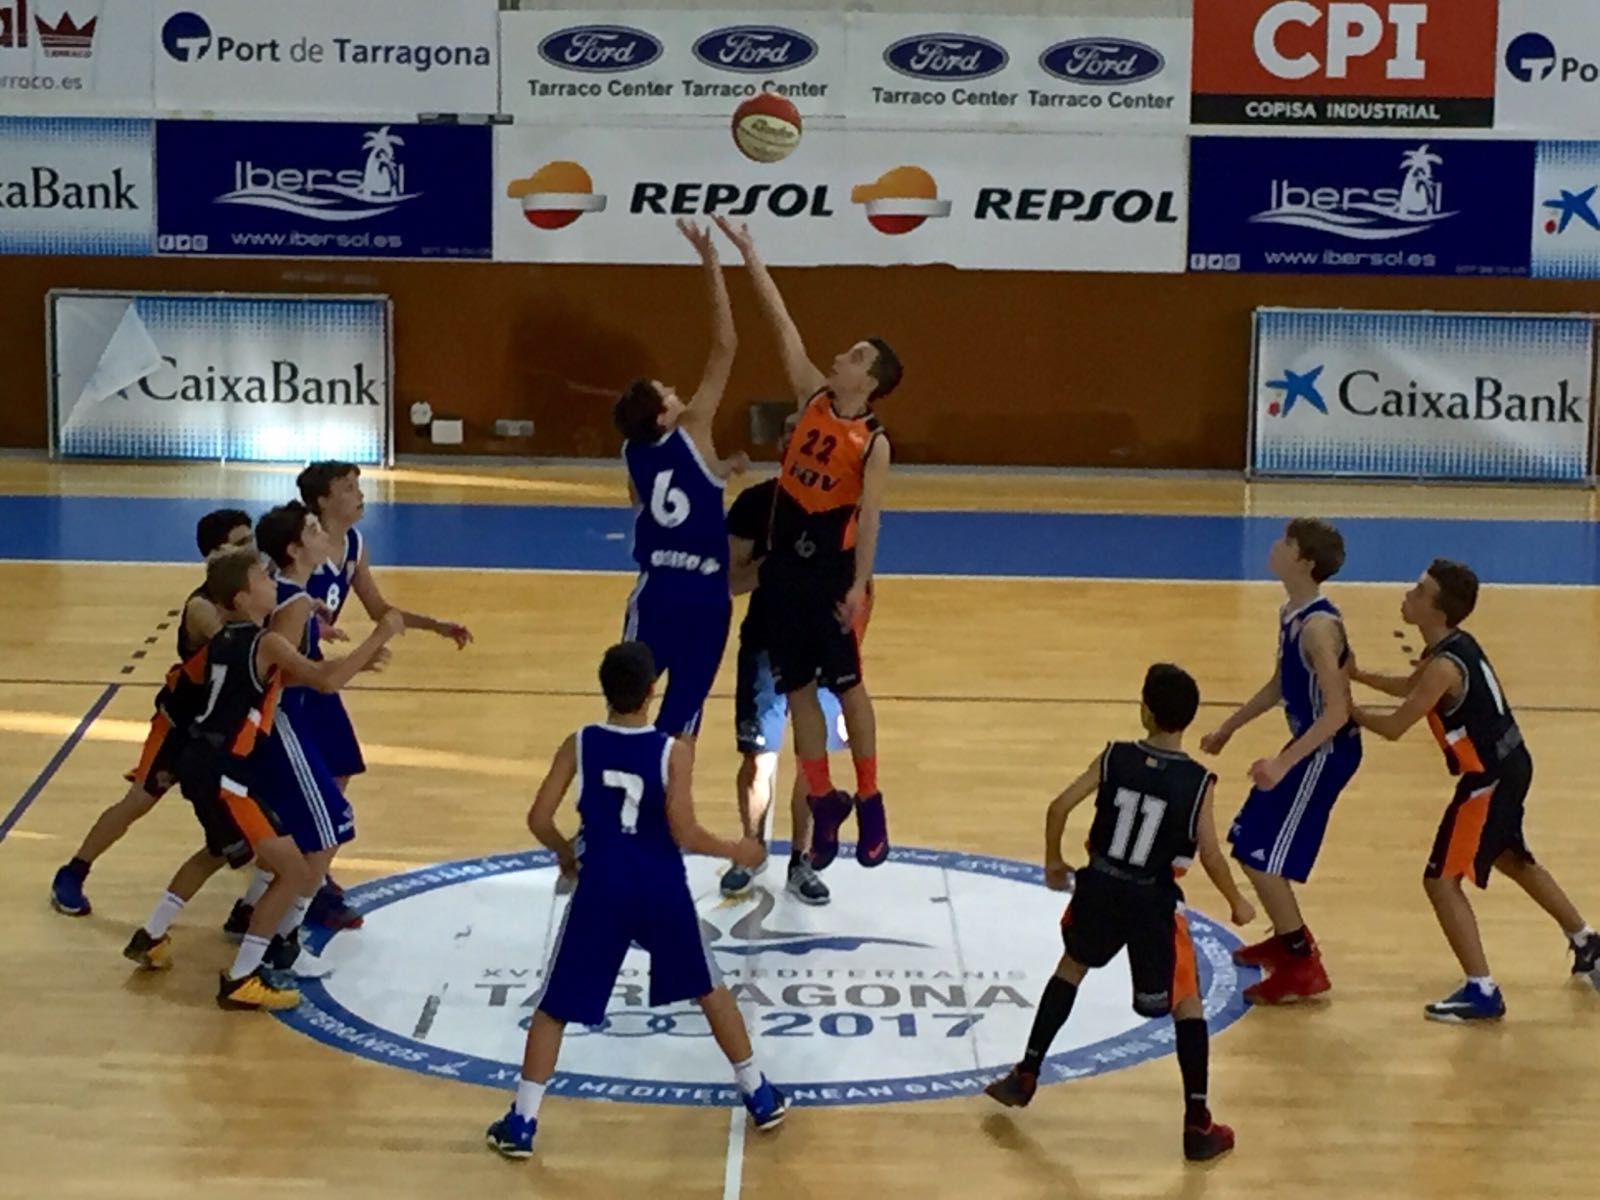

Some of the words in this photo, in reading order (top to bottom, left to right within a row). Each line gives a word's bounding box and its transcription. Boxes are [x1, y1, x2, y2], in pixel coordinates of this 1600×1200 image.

[217, 37, 280, 62] Port
[290, 39, 324, 62] de
[333, 39, 490, 70] Tarragona
[564, 31, 636, 63] Ford
[719, 31, 790, 64] Ford
[1253, 0, 1427, 80] CPI
[909, 41, 981, 72] Ford
[1065, 45, 1138, 76] Ford
[1561, 57, 1599, 83] Po
[0, 75, 83, 91] rraco.es
[528, 79, 601, 97] Tarraco
[607, 80, 674, 97] Center
[682, 80, 756, 97] Tarraco
[761, 80, 828, 97] Center
[872, 87, 946, 105] Tarraco
[952, 88, 1018, 106] Center
[1028, 90, 1101, 108] Tarraco
[1108, 91, 1174, 109] Center
[1245, 101, 1317, 119] COPISA
[1326, 102, 1440, 120] INDUSTRIAL
[630, 183, 834, 217] REPSOL
[974, 188, 1179, 223] REPSOL
[232, 231, 402, 248] www.ibersol.es
[1265, 250, 1436, 267] www.ibersol.es
[138, 355, 380, 407] CaixaBank
[1338, 370, 1583, 423] CaixaBank
[800, 429, 837, 465] 22
[651, 469, 690, 528] 6
[327, 583, 340, 611] 8
[603, 770, 644, 834] 7
[1107, 786, 1168, 867] 11
[475, 983, 1035, 1008] TRAGONA
[760, 1012, 985, 1037] 2017
[578, 1077, 893, 1102] MEDITERNEAN
